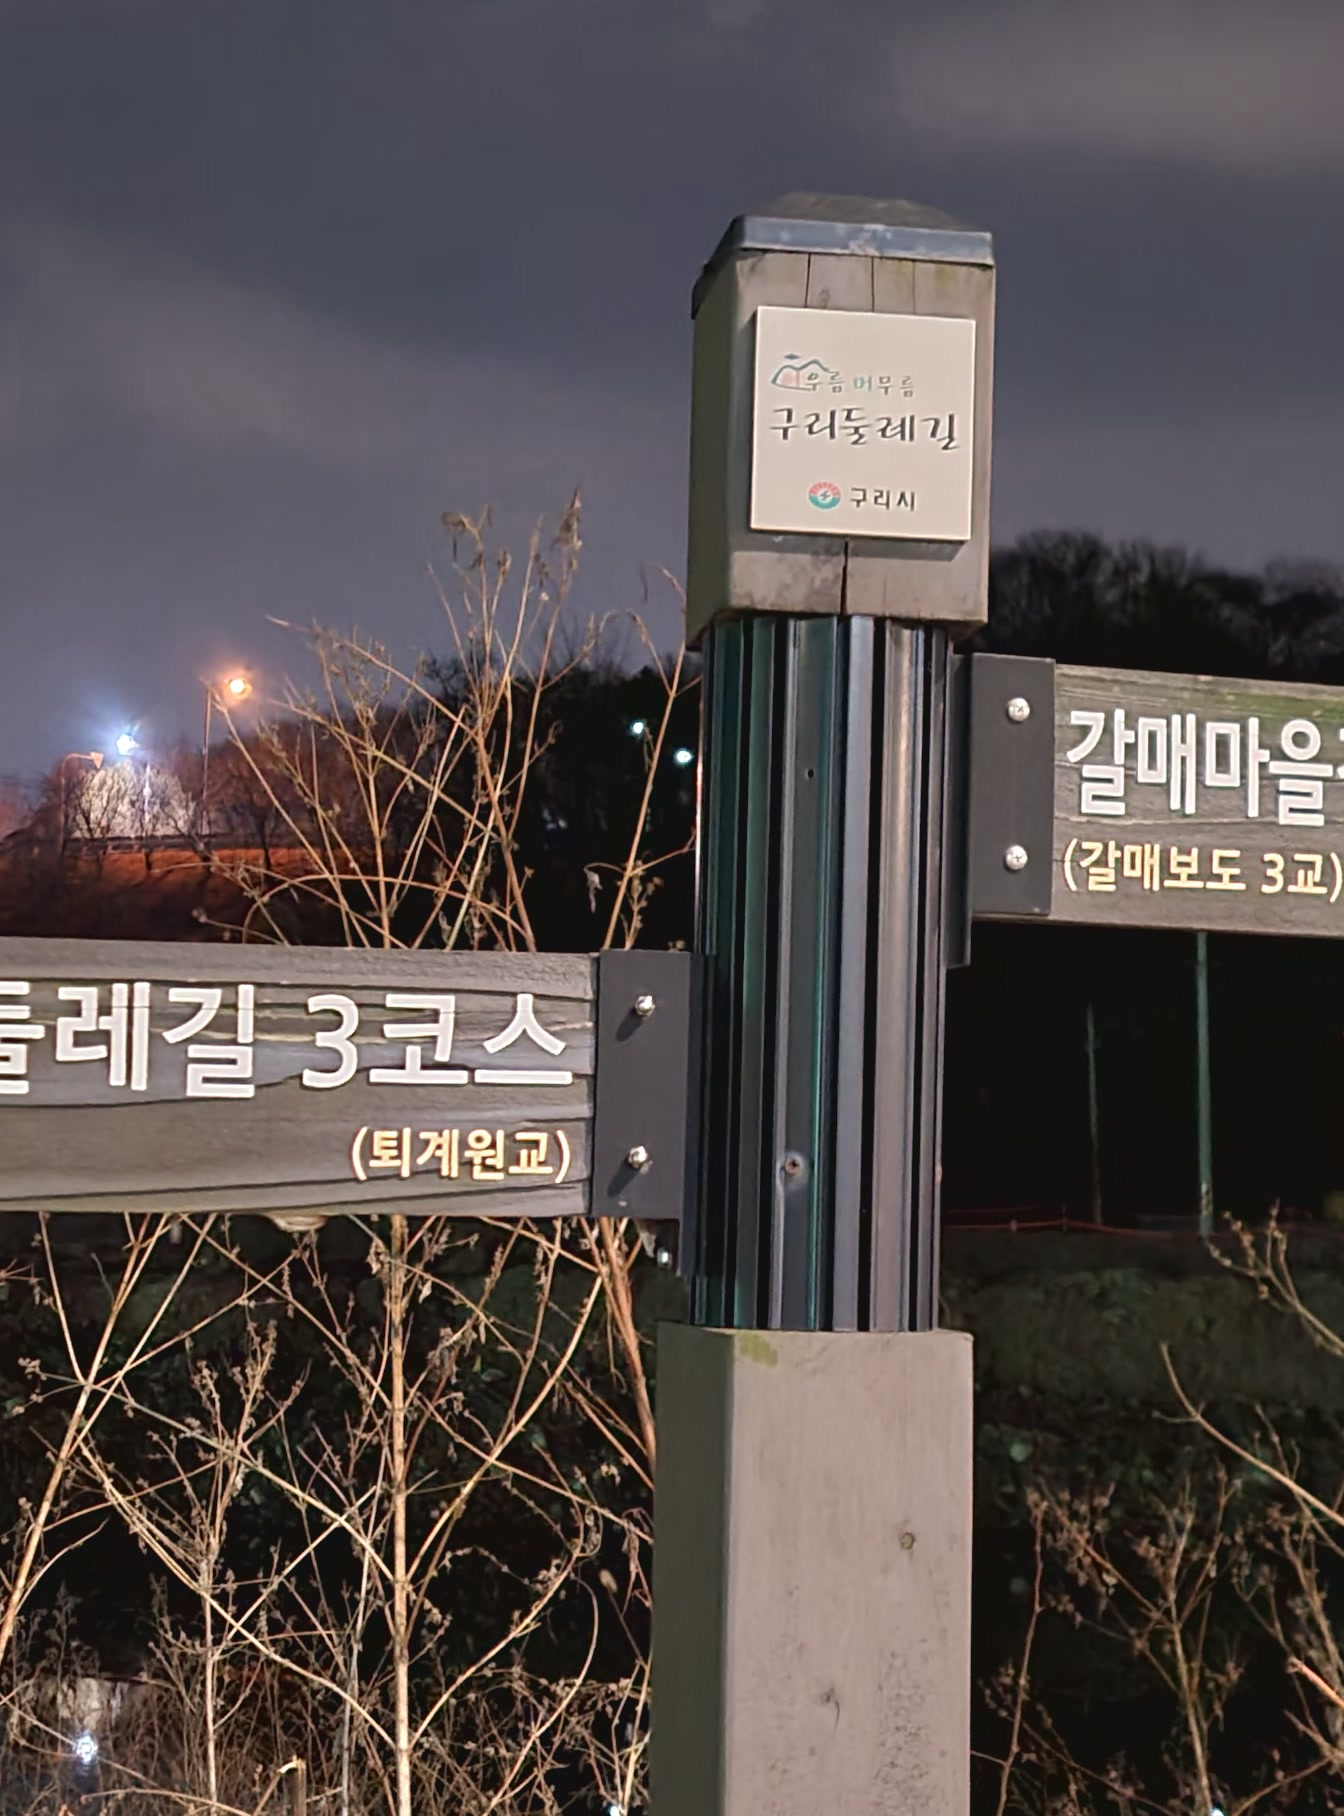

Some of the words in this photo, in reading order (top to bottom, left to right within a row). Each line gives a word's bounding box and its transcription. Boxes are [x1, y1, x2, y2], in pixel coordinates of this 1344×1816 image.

[770, 408, 959, 451] 구리둘레길
[850, 487, 916, 512] 구리시
[1063, 838, 1248, 893] (갈매보도
[1261, 851, 1344, 903] 3교)
[301, 993, 573, 1089] 3코스
[350, 1126, 572, 1184] (퇴계원교)
